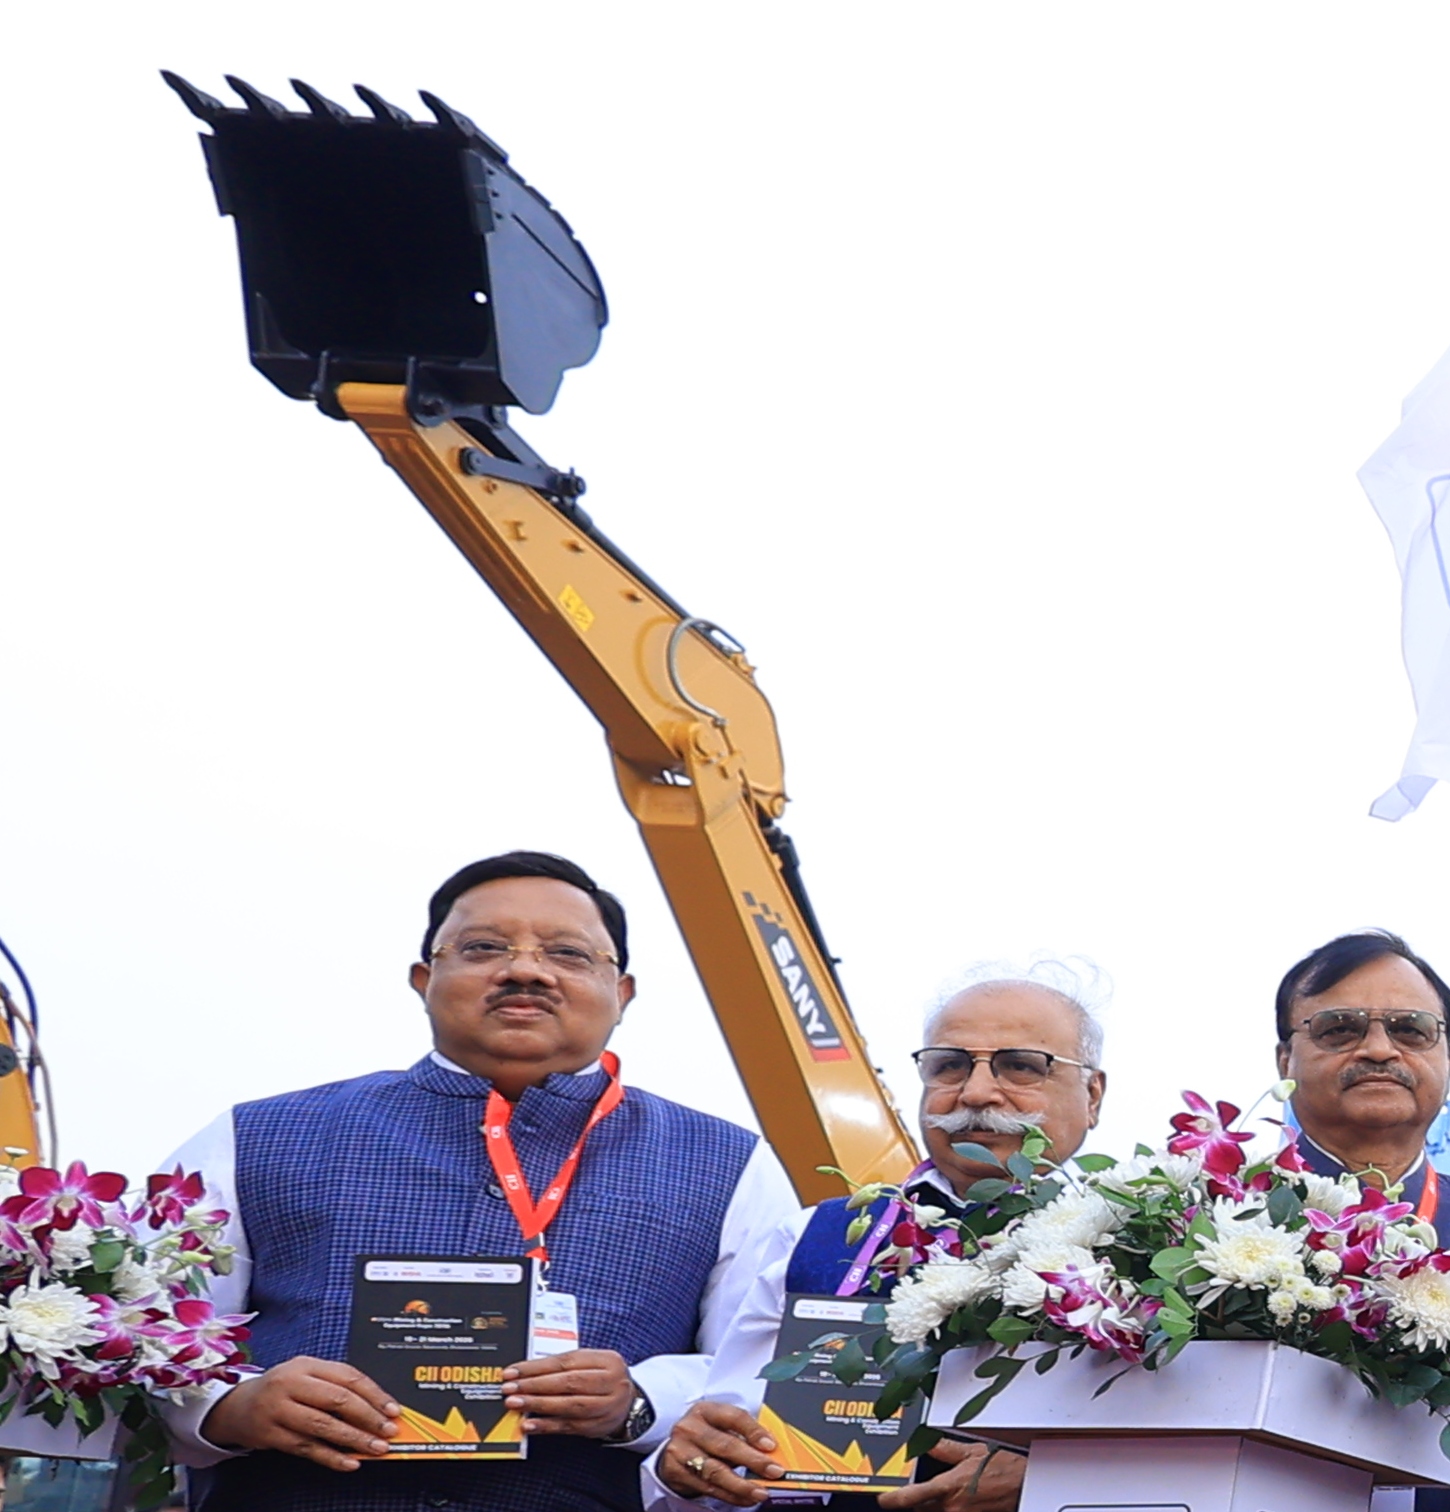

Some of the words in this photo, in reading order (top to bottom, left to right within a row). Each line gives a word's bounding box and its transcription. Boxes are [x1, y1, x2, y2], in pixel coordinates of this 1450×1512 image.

[771, 935, 826, 1035] SANY
[505, 1174, 520, 1191] CII
[875, 1223, 889, 1238] CII
[849, 1267, 863, 1282] CII
[415, 1366, 438, 1381] CII
[440, 1366, 503, 1382] ODISHA
[824, 1400, 846, 1415] CII
[785, 1473, 824, 1481] EXHIBITOR
[825, 1475, 869, 1483] CATALOGUE
